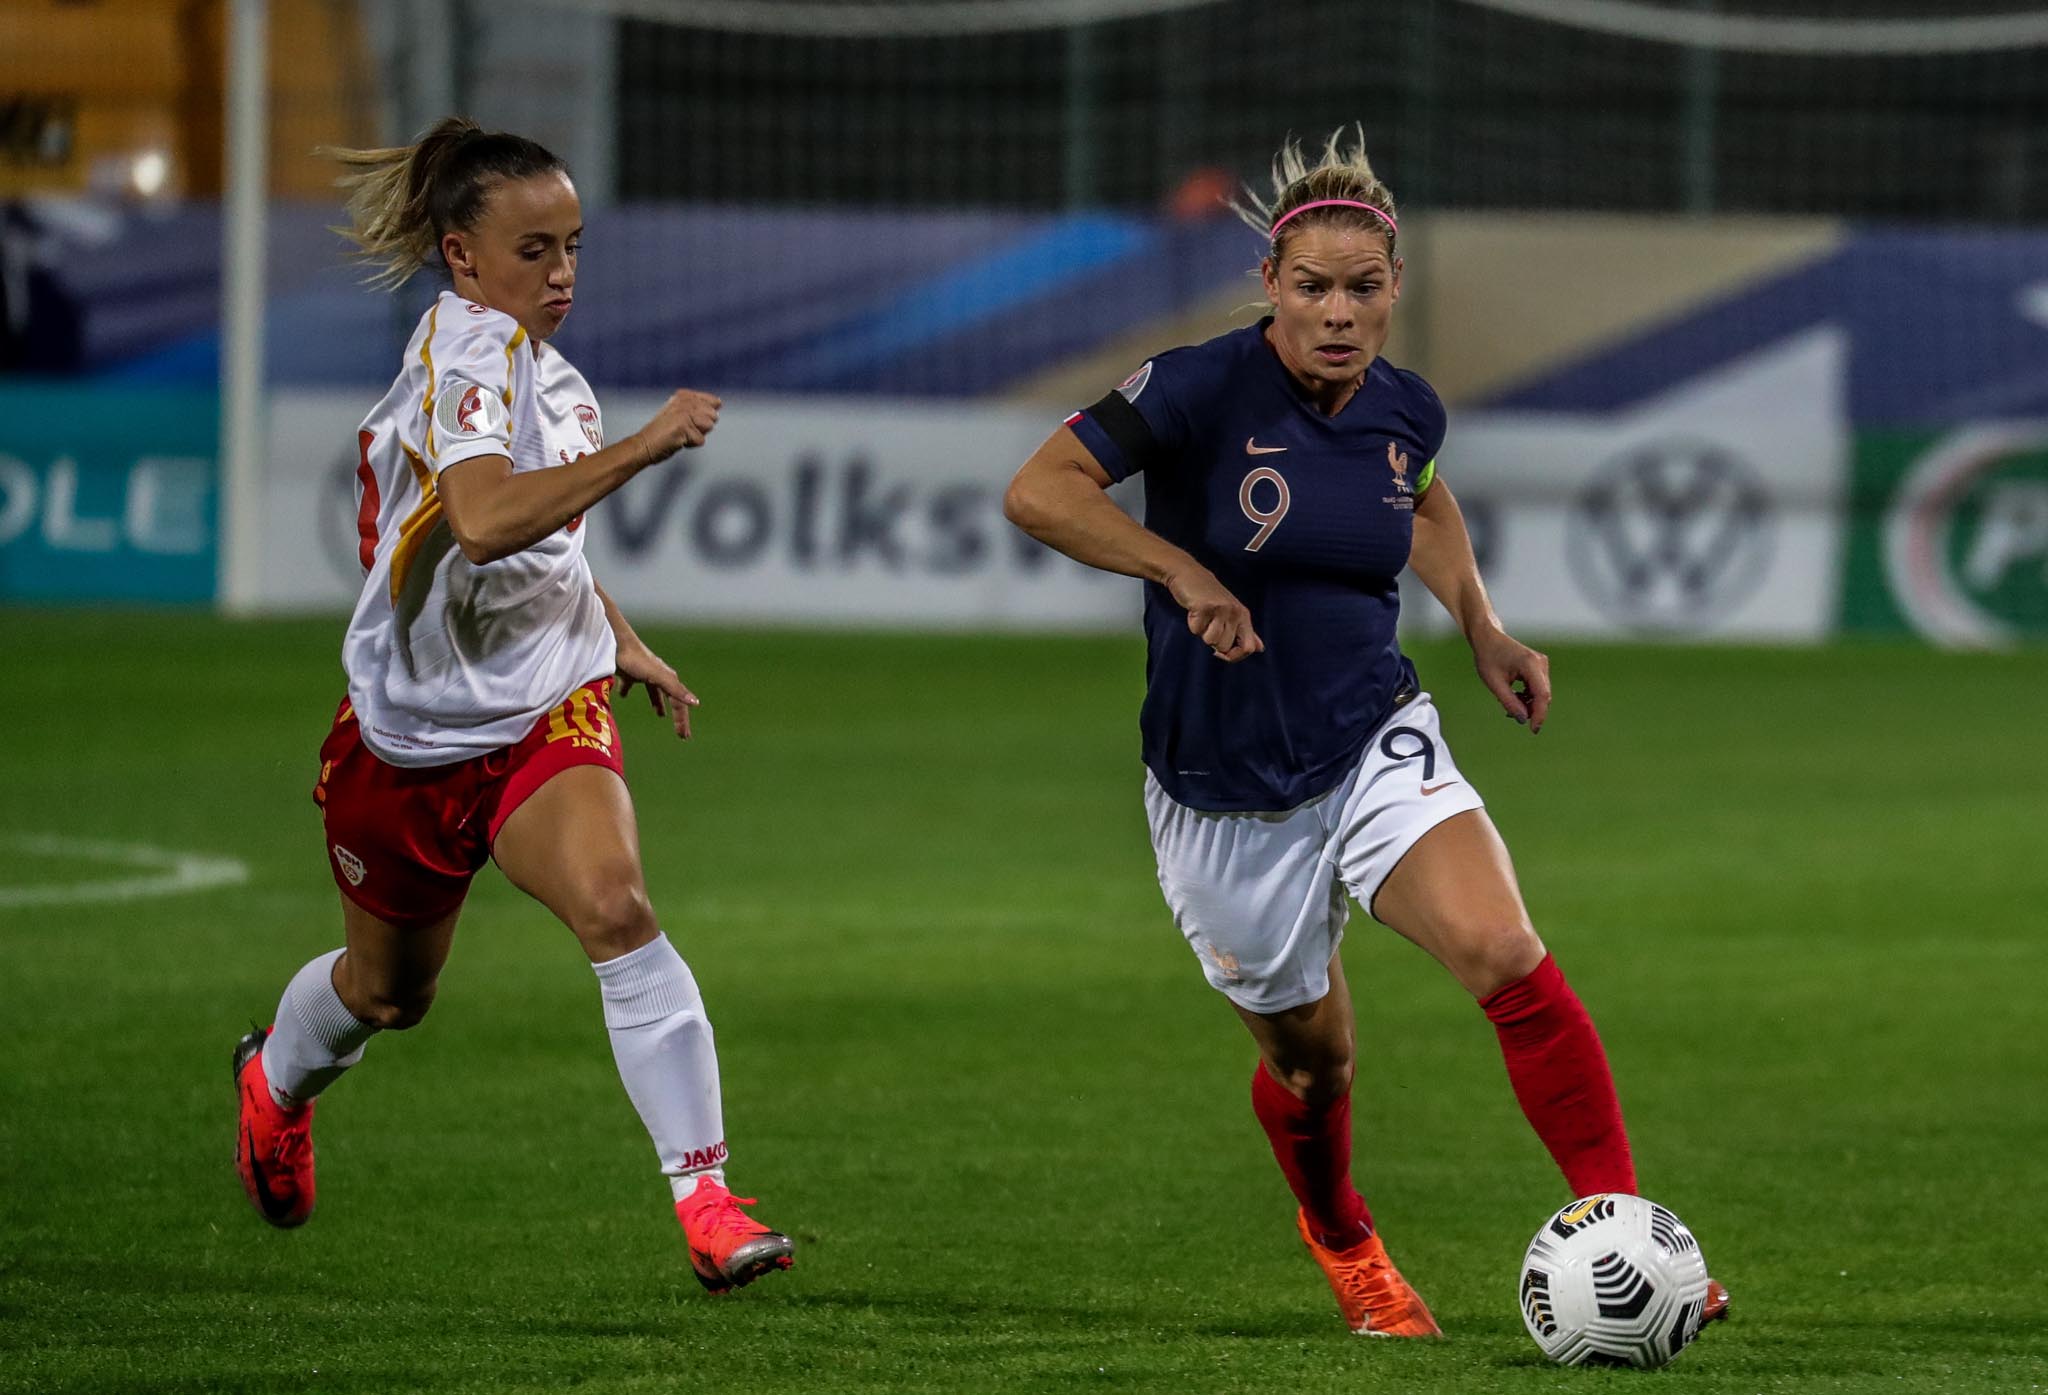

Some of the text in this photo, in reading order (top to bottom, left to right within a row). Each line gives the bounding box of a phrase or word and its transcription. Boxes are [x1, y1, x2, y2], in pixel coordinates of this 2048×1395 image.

[1239, 467, 1290, 552] 9
[545, 687, 612, 748] 10
[571, 736, 612, 758] JAKO
[1380, 726, 1435, 781] 9
[679, 1140, 726, 1169] JAKO
